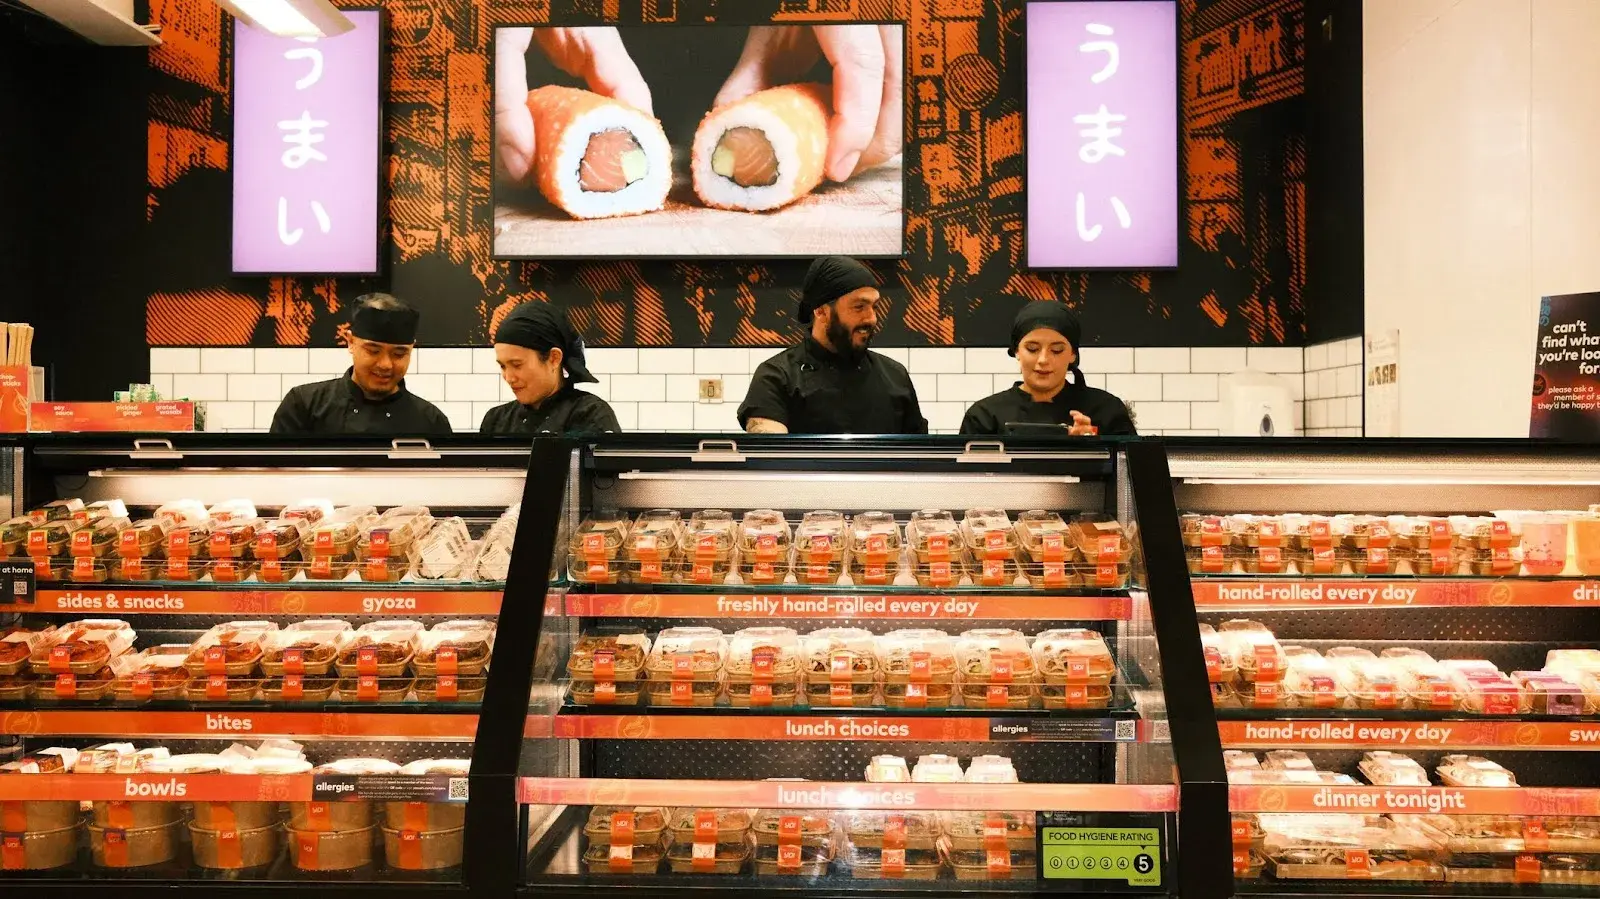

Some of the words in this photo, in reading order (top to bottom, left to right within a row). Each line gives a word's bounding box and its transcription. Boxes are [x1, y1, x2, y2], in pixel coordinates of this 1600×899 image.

[1072, 22, 1132, 242] うまい
[277, 35, 332, 245] うまい
[1553, 320, 1587, 334] can't
[1542, 335, 1567, 348] find
[1570, 334, 1600, 347] wha
[1539, 349, 1578, 365] you're
[1579, 362, 1600, 374] for
[1548, 385, 1572, 394] please
[1573, 385, 1586, 393] ask
[1554, 394, 1585, 402] member
[115, 404, 139, 412] pickled
[155, 404, 177, 412] grated
[1537, 402, 1559, 411] they'd
[1571, 401, 1595, 410] happy
[12, 566, 34, 574] home
[1218, 584, 1323, 600] hand-rolled
[1327, 587, 1378, 604] every
[1382, 584, 1417, 604] day
[1573, 584, 1600, 600] dri
[58, 594, 102, 608] sides
[106, 594, 119, 608] &
[124, 594, 184, 608] snacks
[363, 597, 416, 613] gyoza
[717, 597, 779, 616] freshly
[783, 597, 887, 614] hand-rolled
[889, 600, 941, 616] every
[944, 598, 980, 616] day
[207, 715, 252, 730] bites
[786, 720, 835, 736] lunch
[840, 720, 909, 736] choices
[993, 725, 1028, 734] allergies
[1247, 723, 1354, 739] hand-rolled
[1359, 728, 1411, 743] every
[1416, 723, 1451, 743] day
[1570, 730, 1600, 741] sw
[125, 778, 187, 797] bowls
[316, 782, 354, 793] allergies
[778, 785, 829, 803] lunch
[834, 786, 915, 805] oices
[1313, 788, 1380, 807] dinner
[1384, 789, 1466, 813] tonight
[1049, 832, 1077, 841] FOOD
[1079, 832, 1119, 841] HYGIENE
[1120, 832, 1153, 841] RATING
[1054, 859, 1059, 867] 0
[1086, 859, 1092, 867] 2
[1104, 859, 1109, 867] 3
[1120, 859, 1125, 867] 4
[1138, 856, 1150, 872] 5
